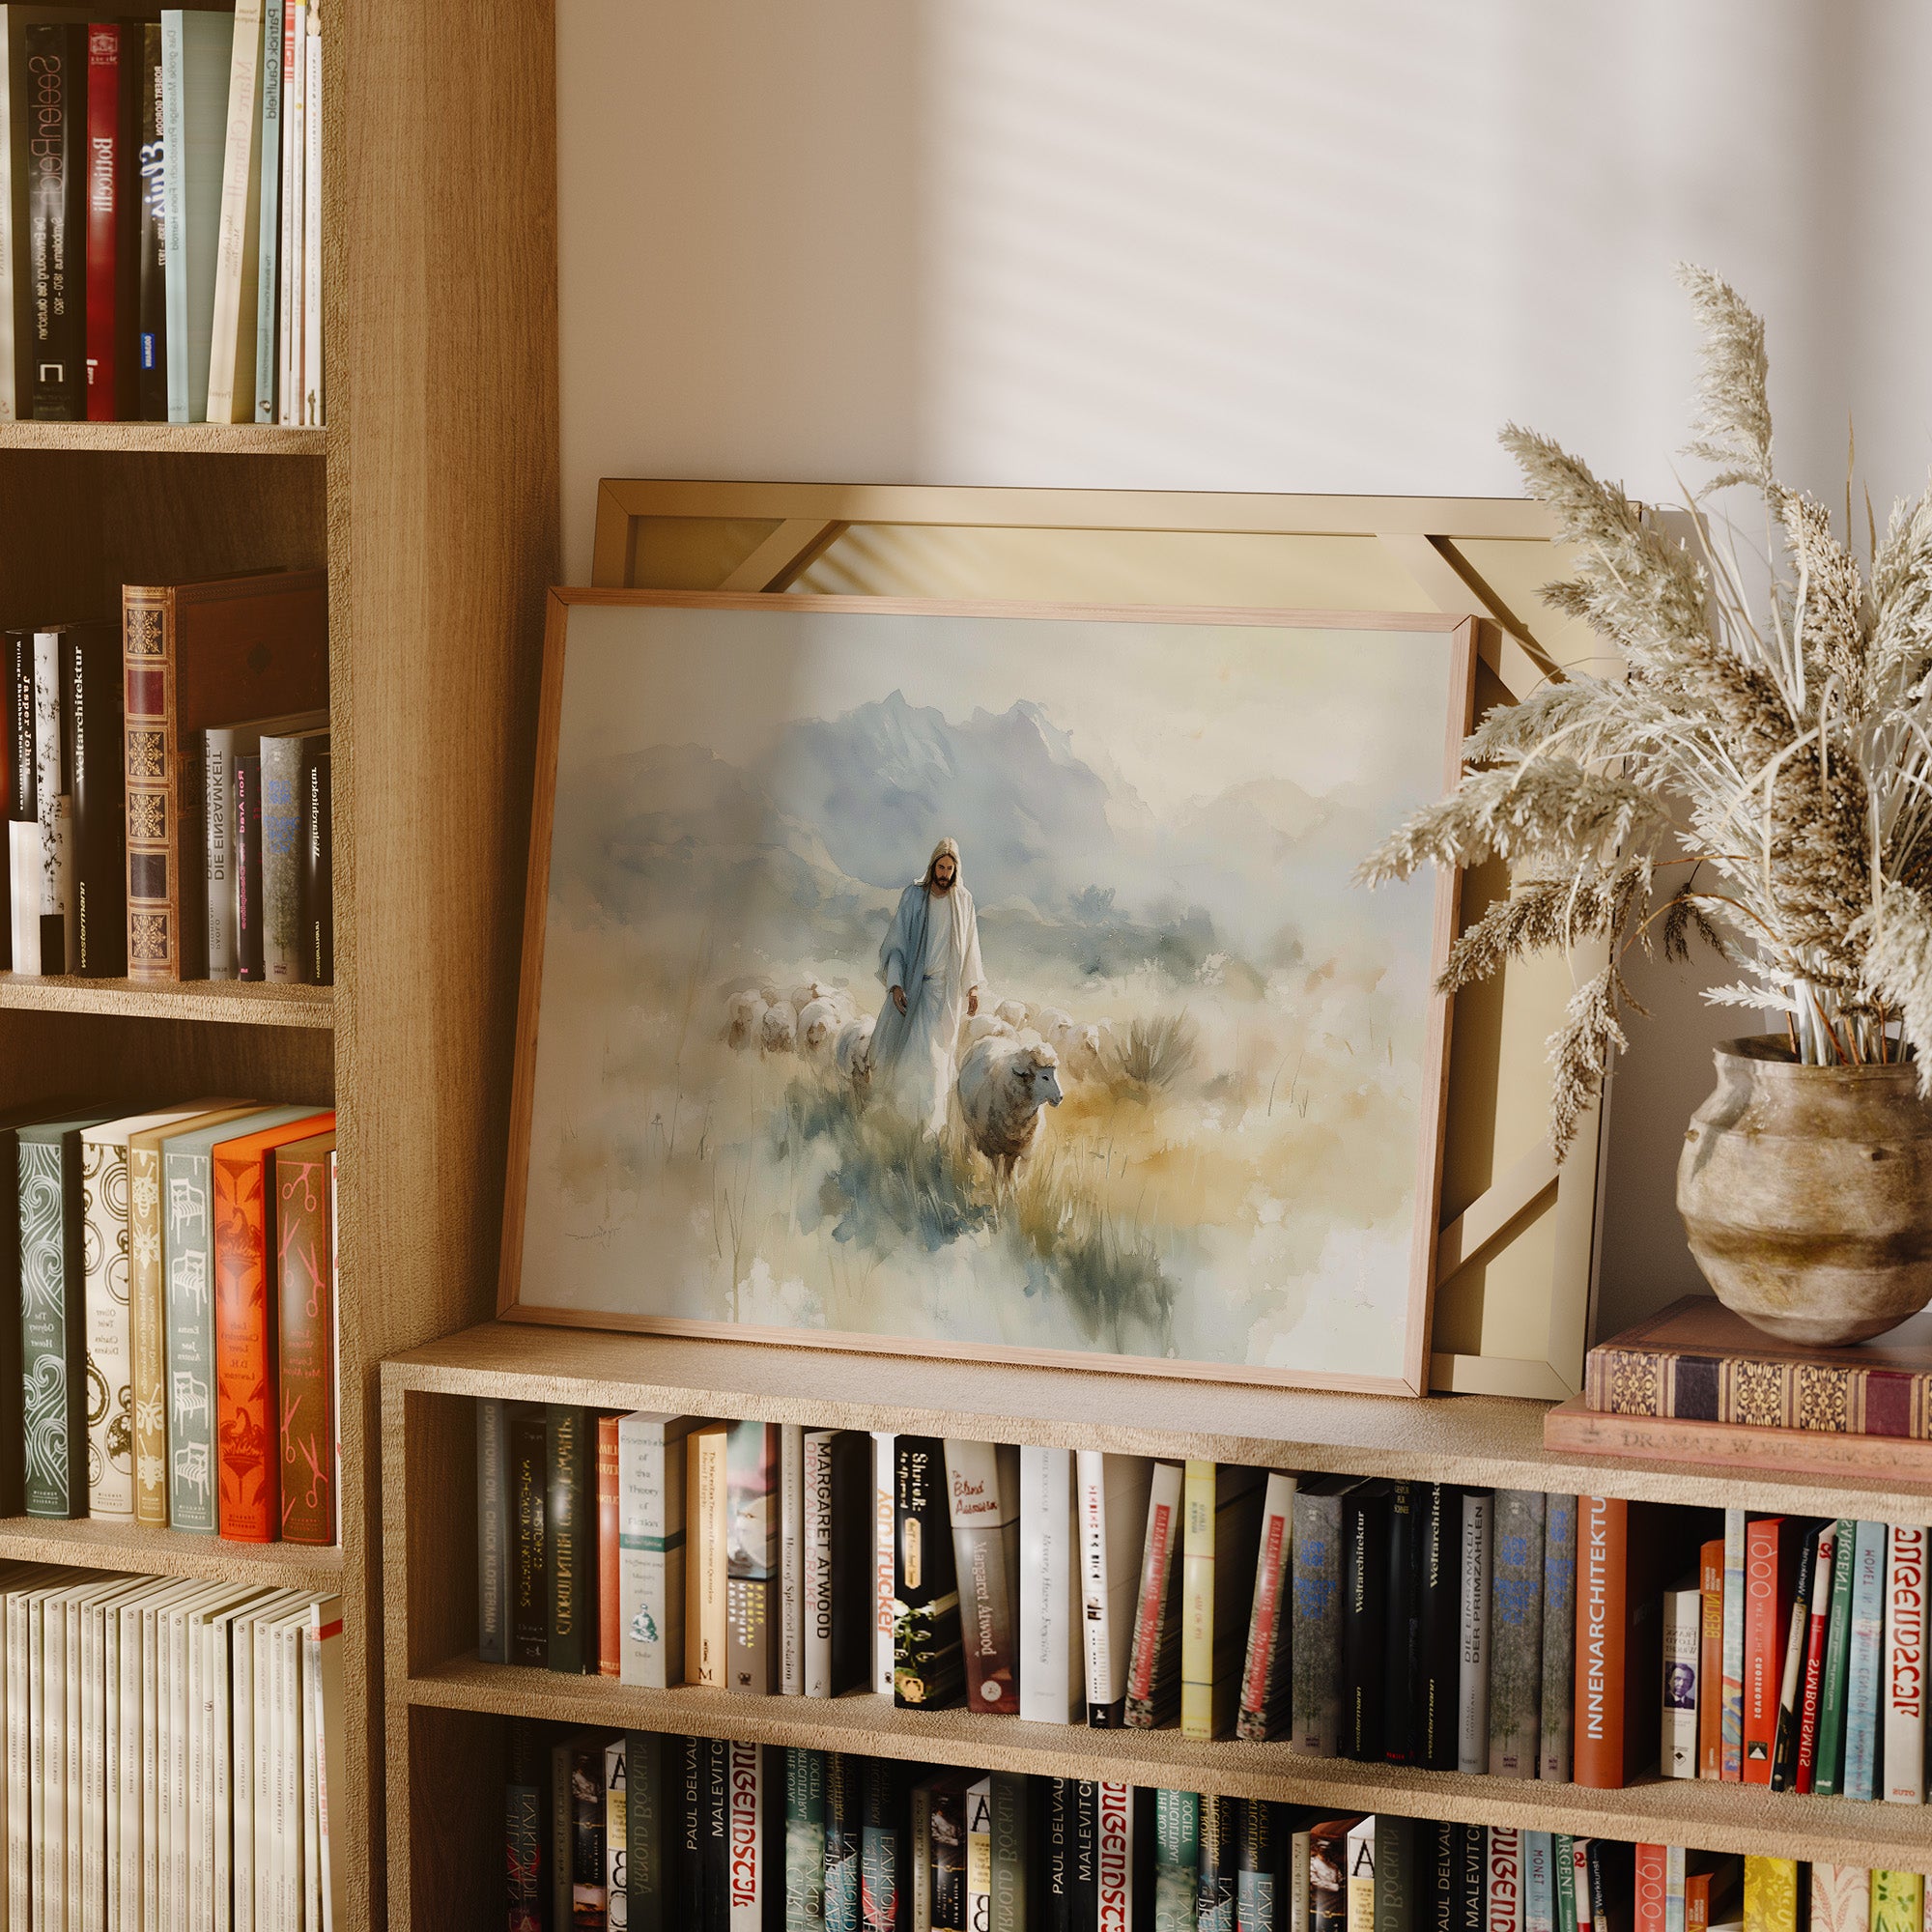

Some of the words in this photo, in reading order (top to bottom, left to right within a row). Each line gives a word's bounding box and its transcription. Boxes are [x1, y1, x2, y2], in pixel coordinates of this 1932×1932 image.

[22, 676, 32, 726] Jasper
[74, 645, 86, 784] Weltarchitektur
[23, 730, 32, 777] Johns
[485, 1406, 497, 1476] DOWNTOWN
[638, 1453, 649, 1462] of
[805, 1440, 818, 1492] ORYX
[485, 1478, 497, 1506] OWL
[629, 1484, 659, 1497] Theory
[636, 1468, 651, 1478] the
[816, 1441, 832, 1551] MARGARET
[628, 1517, 659, 1528] Fiction
[639, 1501, 649, 1510] of
[805, 1497, 818, 1539] AND
[485, 1510, 497, 1552] CHUCK
[805, 1546, 818, 1613] CRAKE
[971, 1540, 990, 1601] Margaret
[1354, 1510, 1365, 1614] Weltarchitektur
[1463, 1521, 1474, 1630] EINSAMKEIT
[1472, 1506, 1484, 1623] PRIMZAHLEN
[485, 1555, 497, 1634] KLOSTERMAN
[816, 1556, 832, 1640] ATWOOD
[1586, 1495, 1607, 1741] INNENARCHITEKTU
[978, 1604, 998, 1656] Atwood
[1463, 1634, 1472, 1663] DIE
[1471, 1627, 1481, 1664] DER
[1427, 1678, 1435, 1759] westermann
[686, 1807, 697, 1851] PAUL
[1052, 1851, 1064, 1894] PAUL
[1532, 1849, 1547, 1886] MONET
[1573, 1851, 1587, 1869] 2
[1635, 1855, 1662, 1919] 1900
